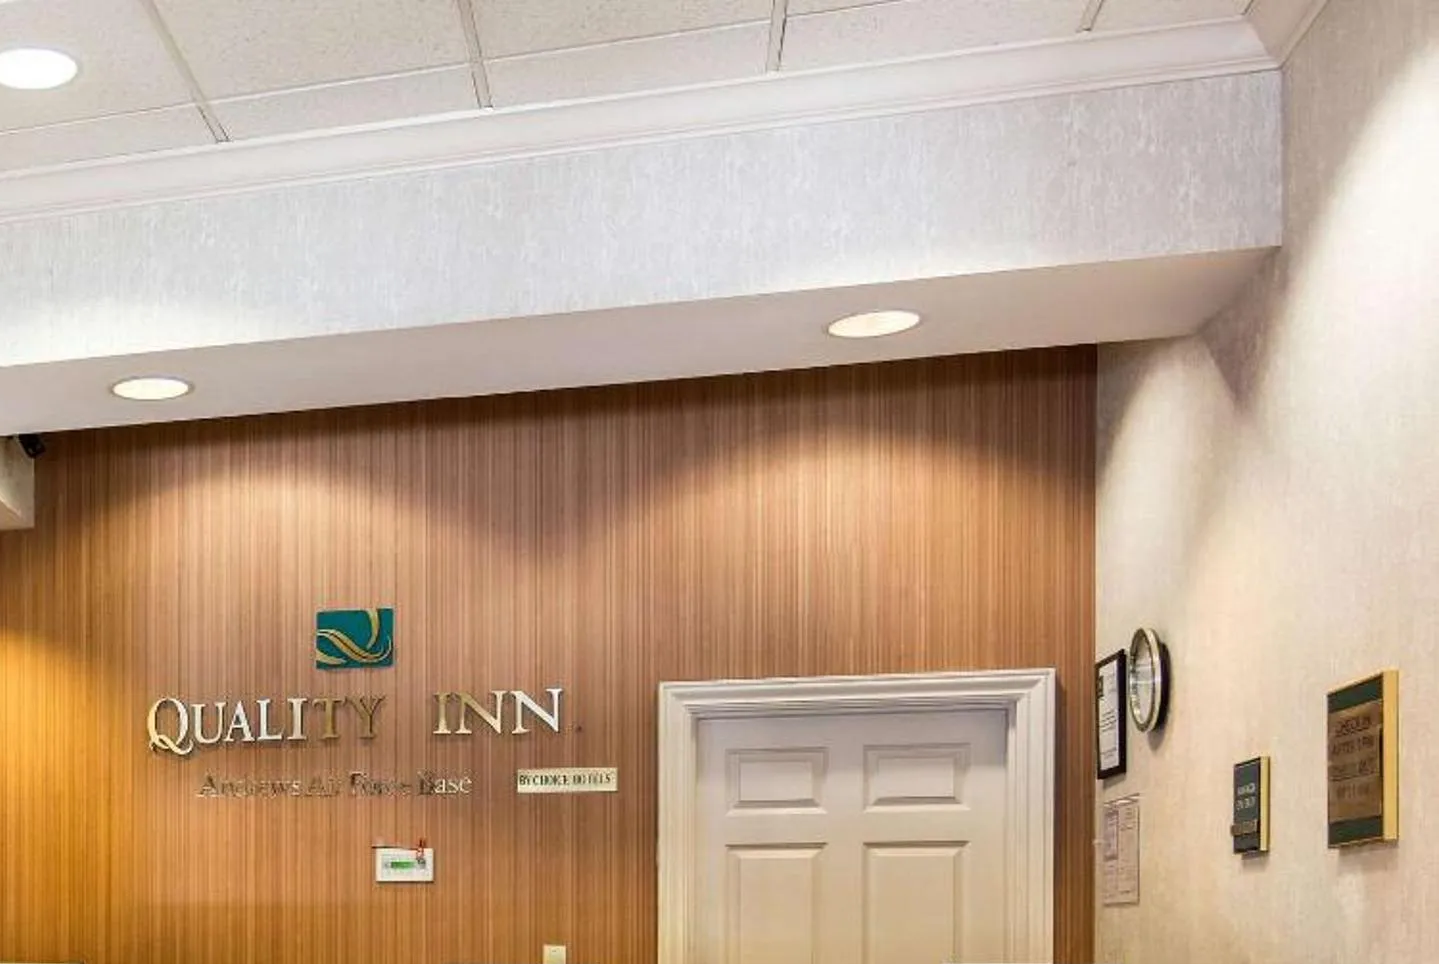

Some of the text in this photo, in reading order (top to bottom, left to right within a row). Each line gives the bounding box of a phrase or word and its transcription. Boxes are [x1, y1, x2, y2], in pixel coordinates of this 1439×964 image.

[147, 688, 563, 756] QUALITY INN
[417, 768, 473, 796] Base
